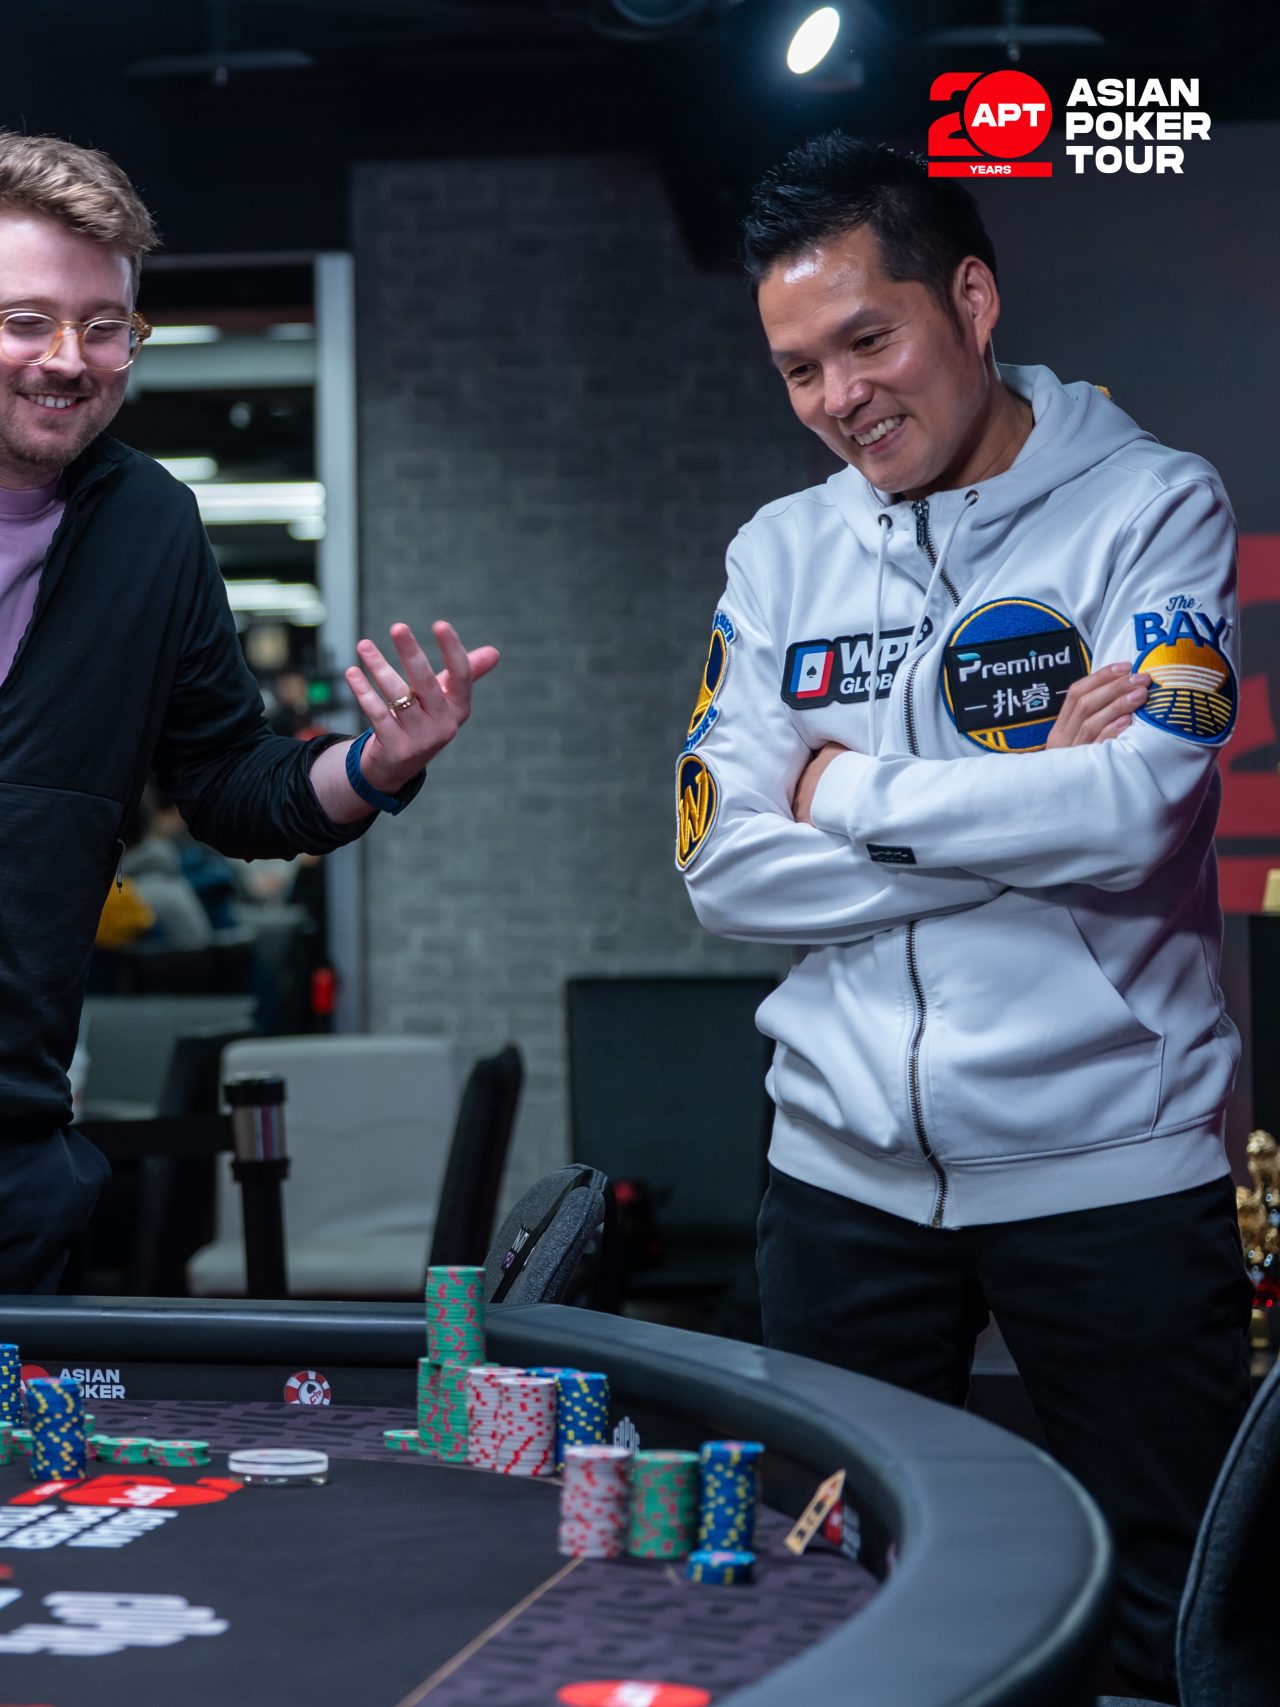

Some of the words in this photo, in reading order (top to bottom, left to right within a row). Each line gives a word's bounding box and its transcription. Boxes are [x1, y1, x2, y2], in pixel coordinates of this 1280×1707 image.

[1166, 595, 1196, 611] The
[1133, 610, 1227, 652] BAY
[957, 646, 1071, 682] Premind
[839, 672, 894, 695] GLOB
[60, 1368, 120, 1383] ASIAN
[80, 1385, 126, 1399] KER
